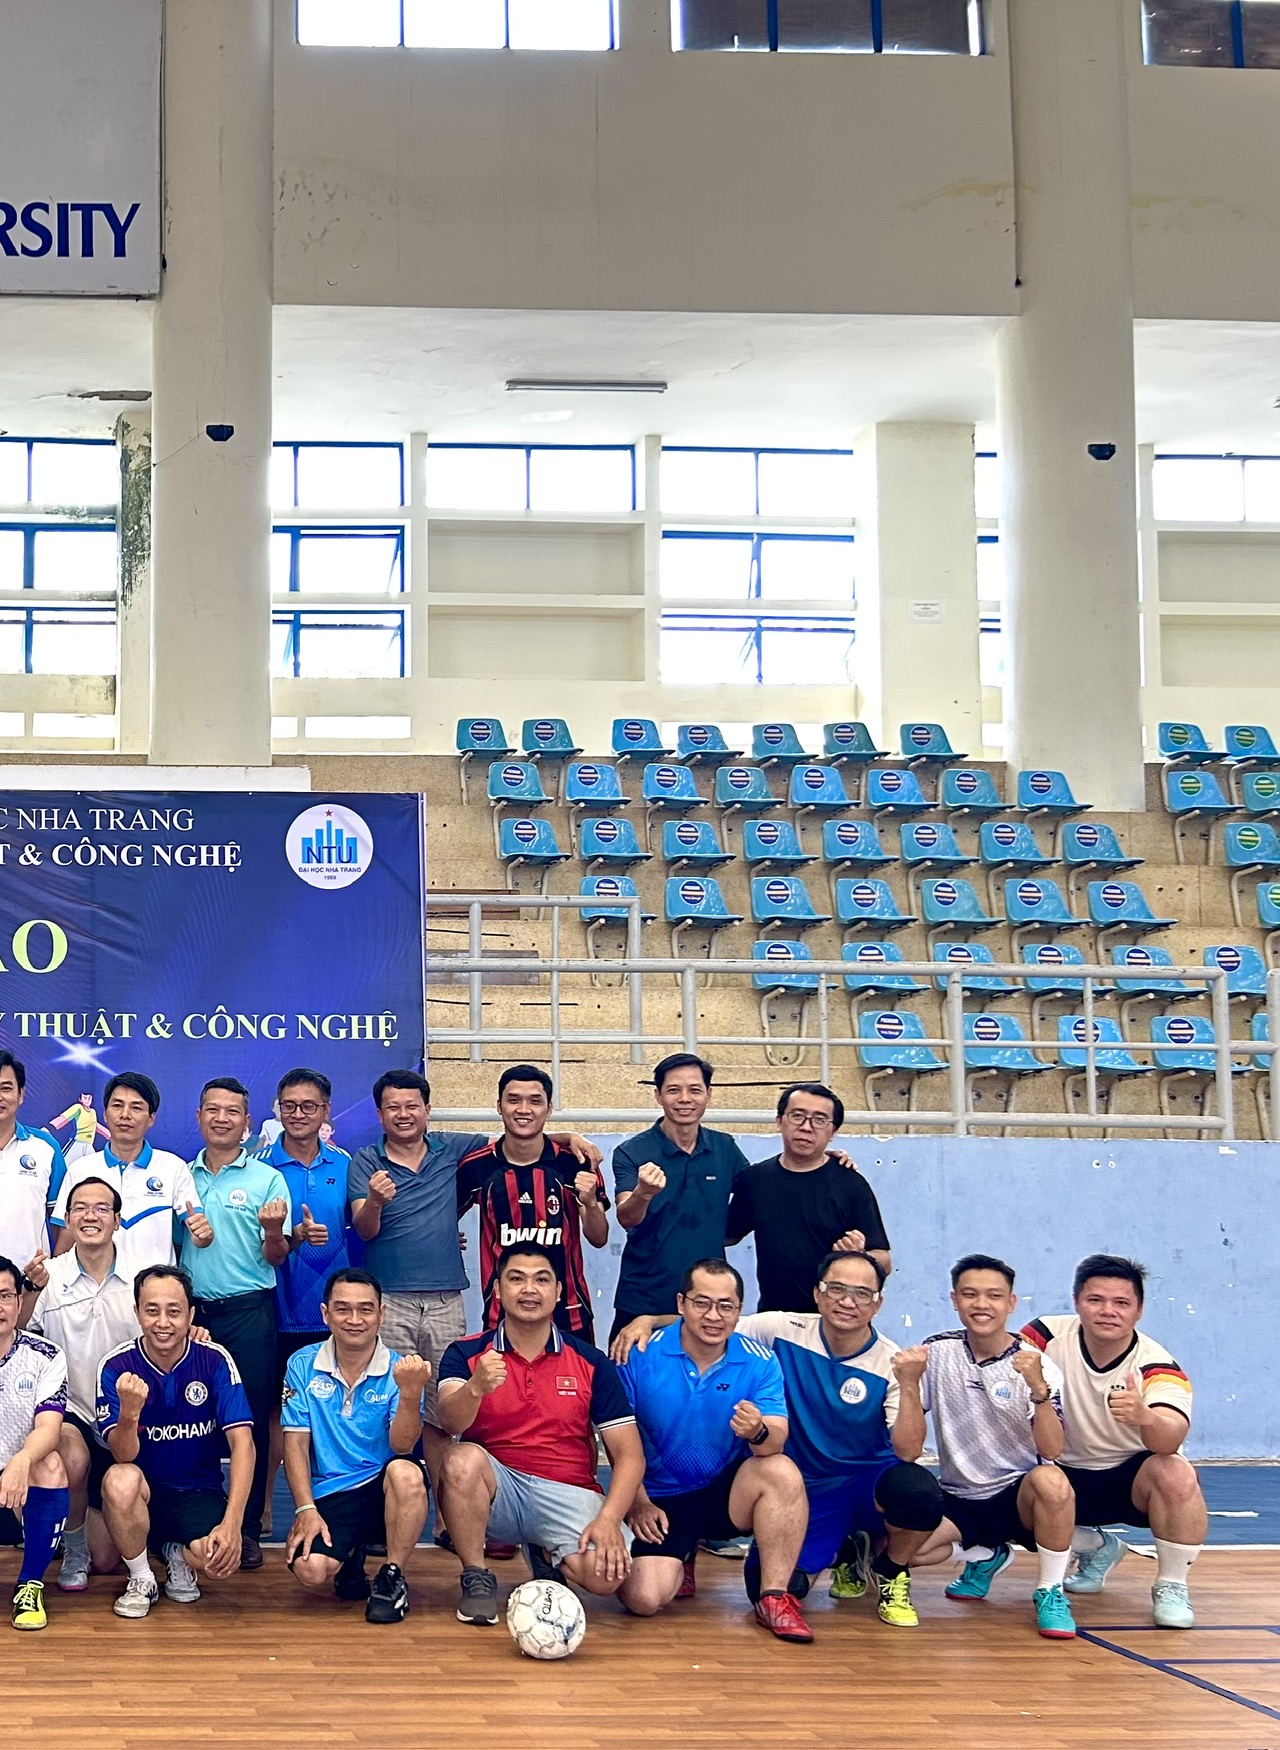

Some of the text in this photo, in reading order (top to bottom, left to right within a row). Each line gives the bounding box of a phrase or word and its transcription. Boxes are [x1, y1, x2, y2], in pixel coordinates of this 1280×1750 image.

[16, 808, 83, 830] NHA
[88, 808, 195, 831] TRANG
[18, 844, 43, 866] &
[51, 837, 144, 867] CÔNG
[151, 841, 242, 873] NGHỆ
[306, 845, 353, 864] NTU
[13, 1009, 138, 1047] THUẬT
[145, 1013, 174, 1039] &
[182, 1004, 288, 1040] CÔNG
[295, 1010, 400, 1047] NGHỆ
[500, 1220, 562, 1246] bwin
[146, 1418, 217, 1441] YOKOHAMA
